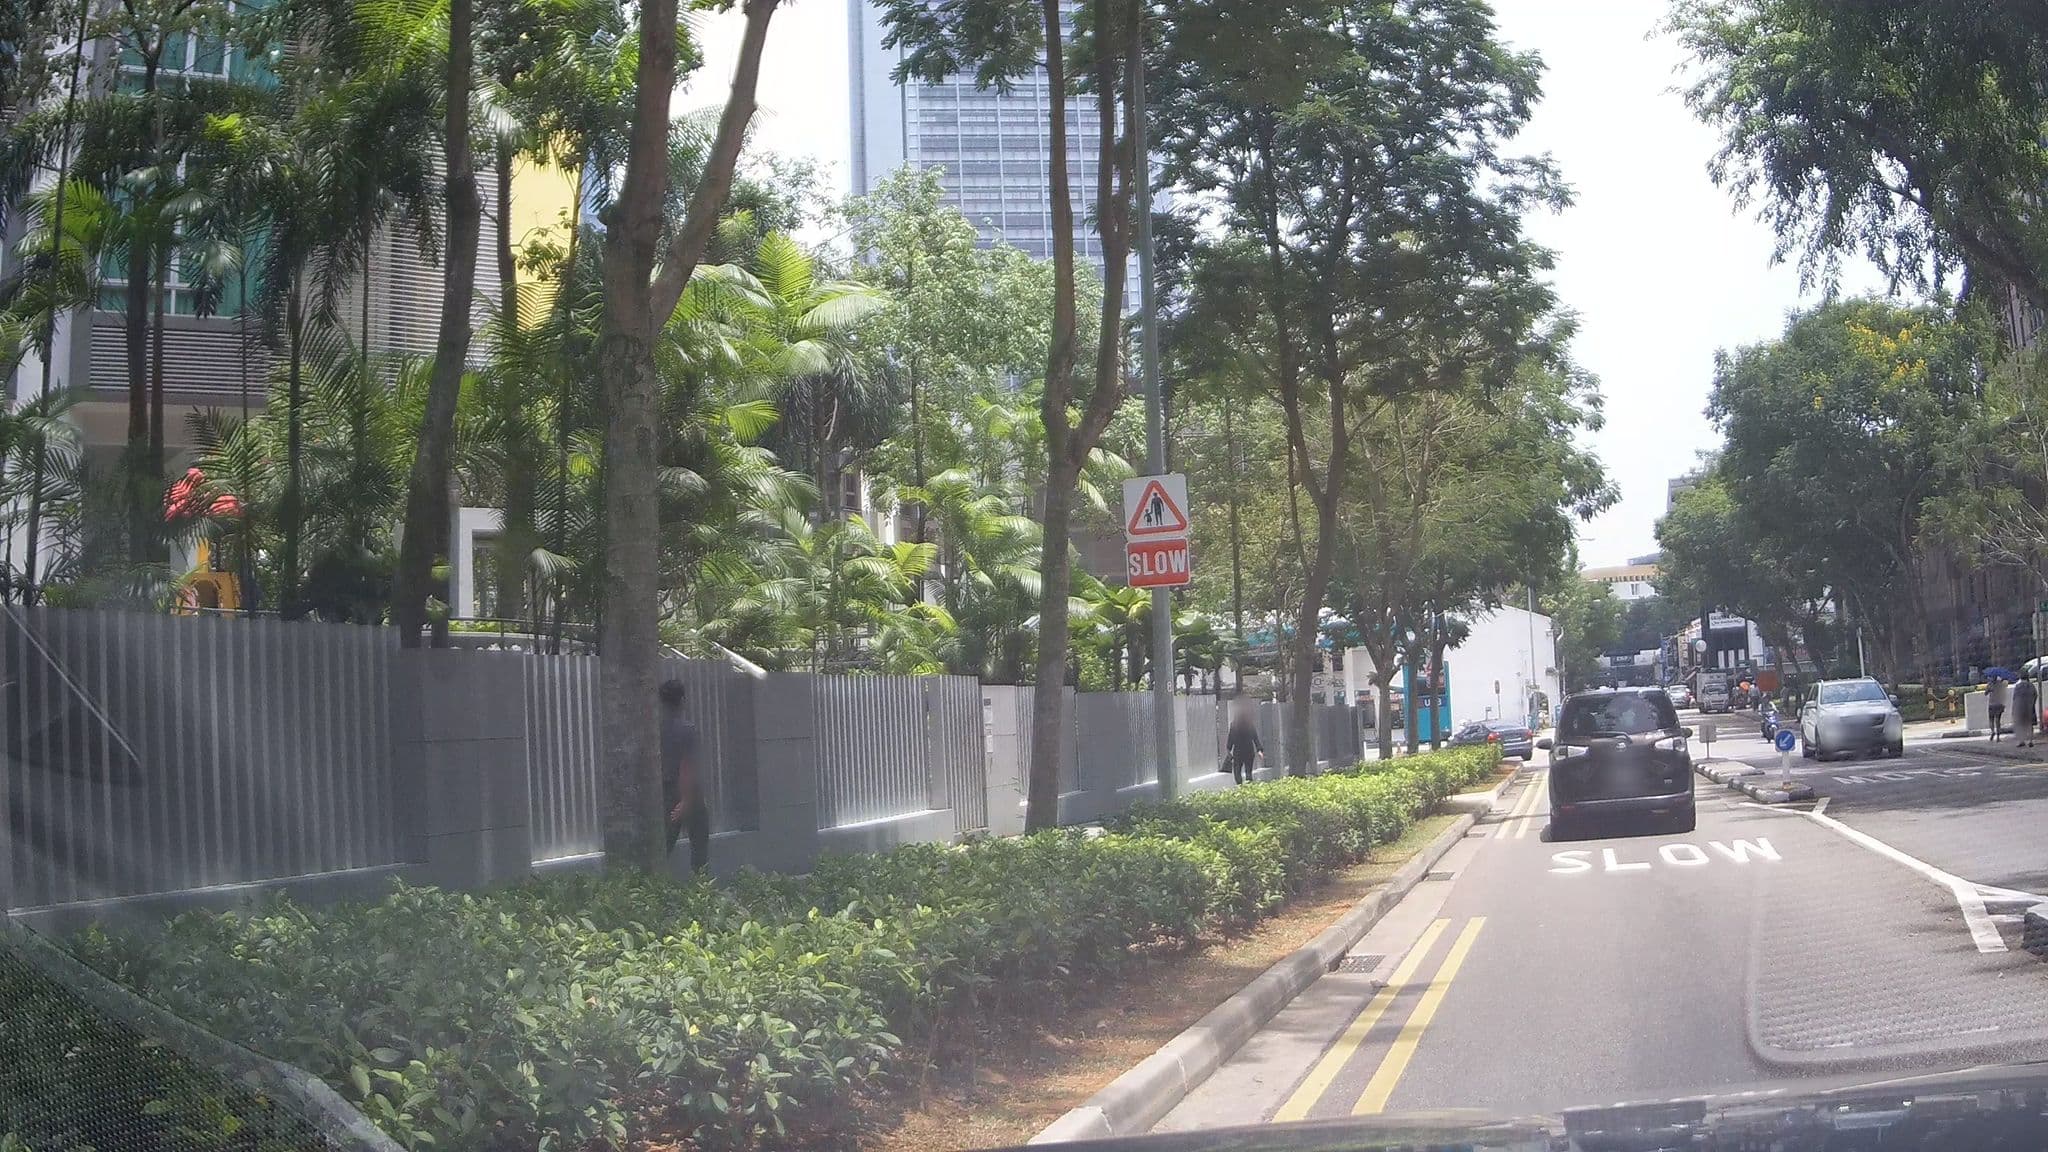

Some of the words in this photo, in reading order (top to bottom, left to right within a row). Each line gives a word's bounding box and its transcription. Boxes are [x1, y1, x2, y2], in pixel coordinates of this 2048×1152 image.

[1129, 549, 1186, 577] SLOW
[1424, 698, 1442, 707] UB
[1548, 837, 1783, 873] SLOW
